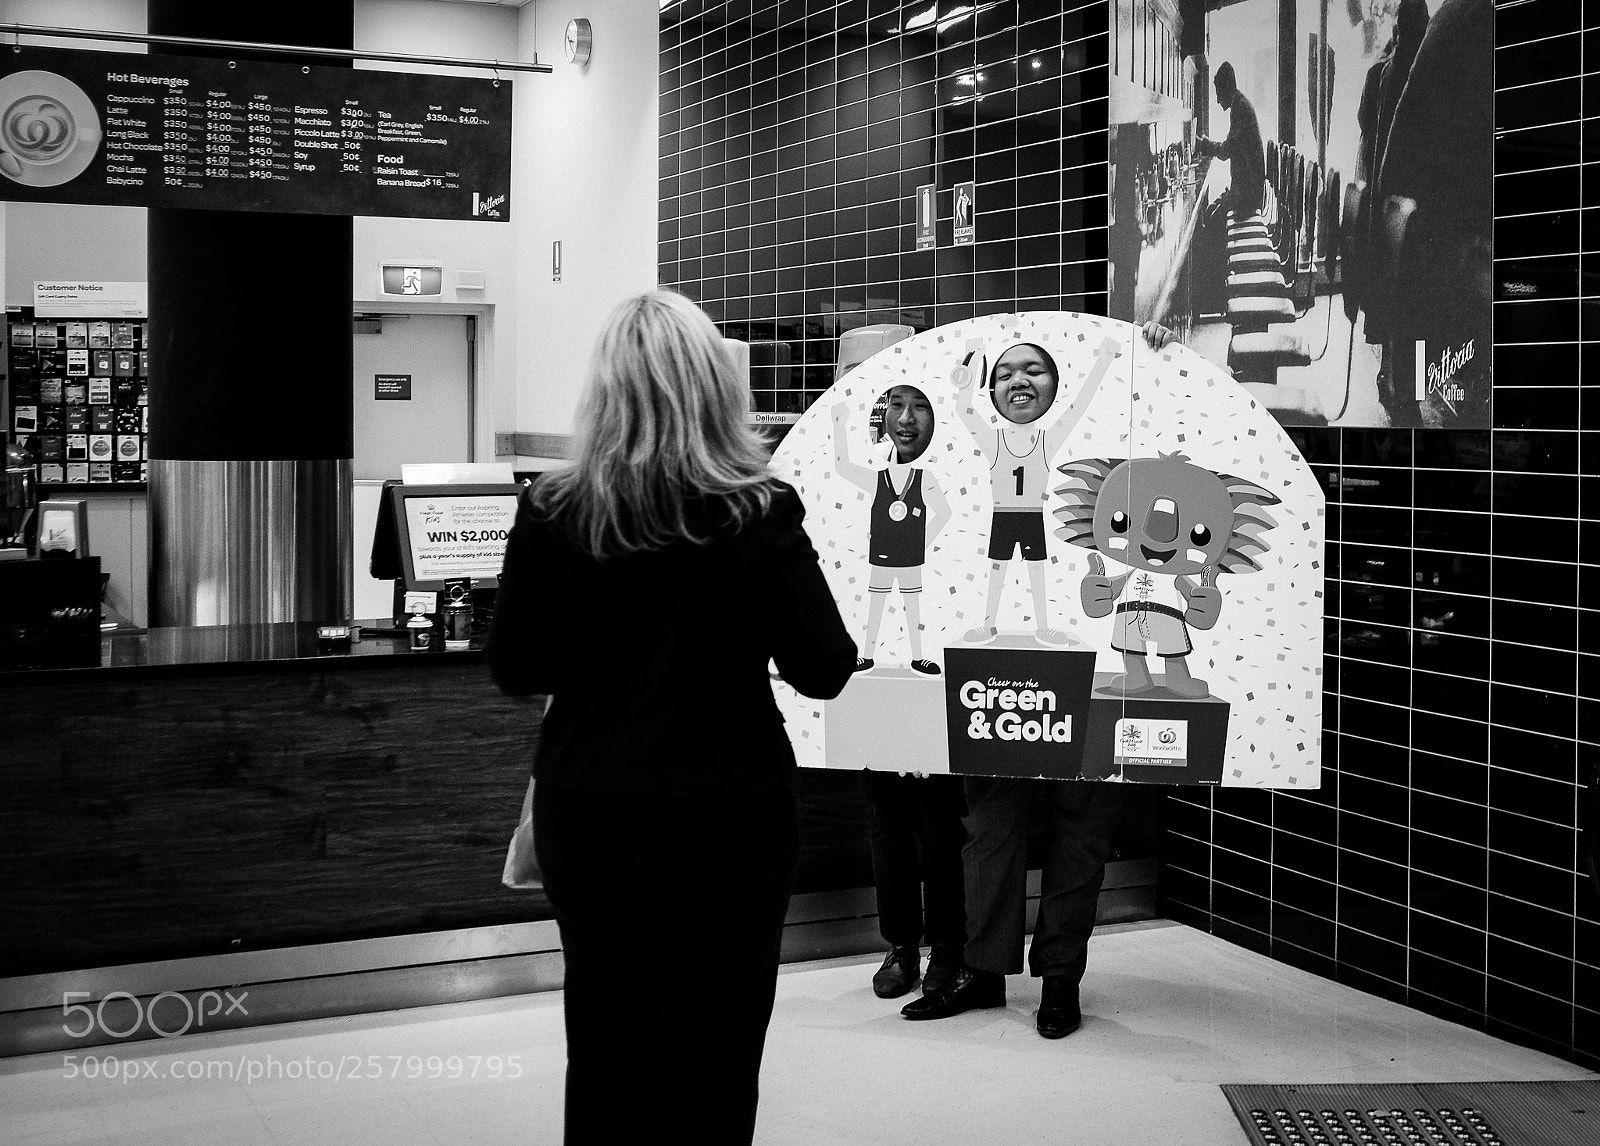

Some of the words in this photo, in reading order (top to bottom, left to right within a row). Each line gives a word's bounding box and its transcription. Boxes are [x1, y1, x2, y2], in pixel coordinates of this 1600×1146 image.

[107, 72, 129, 82] Hot
[130, 74, 190, 88] Beverages
[107, 94, 156, 104] Cappuccino
[107, 106, 128, 114] Latte
[294, 106, 328, 115] Espresso
[378, 111, 392, 119] Tea
[107, 118, 122, 126] Flat
[123, 119, 147, 127] White
[294, 118, 332, 126] Macchiato
[107, 130, 127, 140] Long
[128, 131, 149, 139] Black
[294, 129, 320, 137] Piccolo
[321, 130, 340, 138] Latte
[123, 143, 163, 151] Chocolate
[294, 140, 320, 149] Double
[321, 141, 339, 149] Shot
[107, 154, 134, 162] Mocha
[294, 151, 309, 160] Soy
[377, 154, 404, 164] Food
[107, 165, 125, 173] Chai
[126, 166, 148, 174] Latte
[294, 162, 316, 172] Syrup
[377, 167, 398, 175] Raisin
[399, 168, 419, 176] Toast
[107, 177, 144, 187] Babycino
[377, 178, 404, 186] Banana
[405, 179, 426, 188] Bread
[78, 284, 103, 292] Notice
[1427, 338, 1475, 395] Vittoria
[1442, 383, 1465, 402] Coffee
[1012, 465, 1025, 497] 1
[427, 531, 458, 543] WIN
[460, 529, 508, 544] $2,000
[987, 677, 1011, 687] Cheer
[1012, 680, 1024, 688] on
[1025, 678, 1039, 688] the
[960, 680, 1056, 712] Green
[967, 710, 993, 740] &
[995, 711, 1073, 743] Gold
